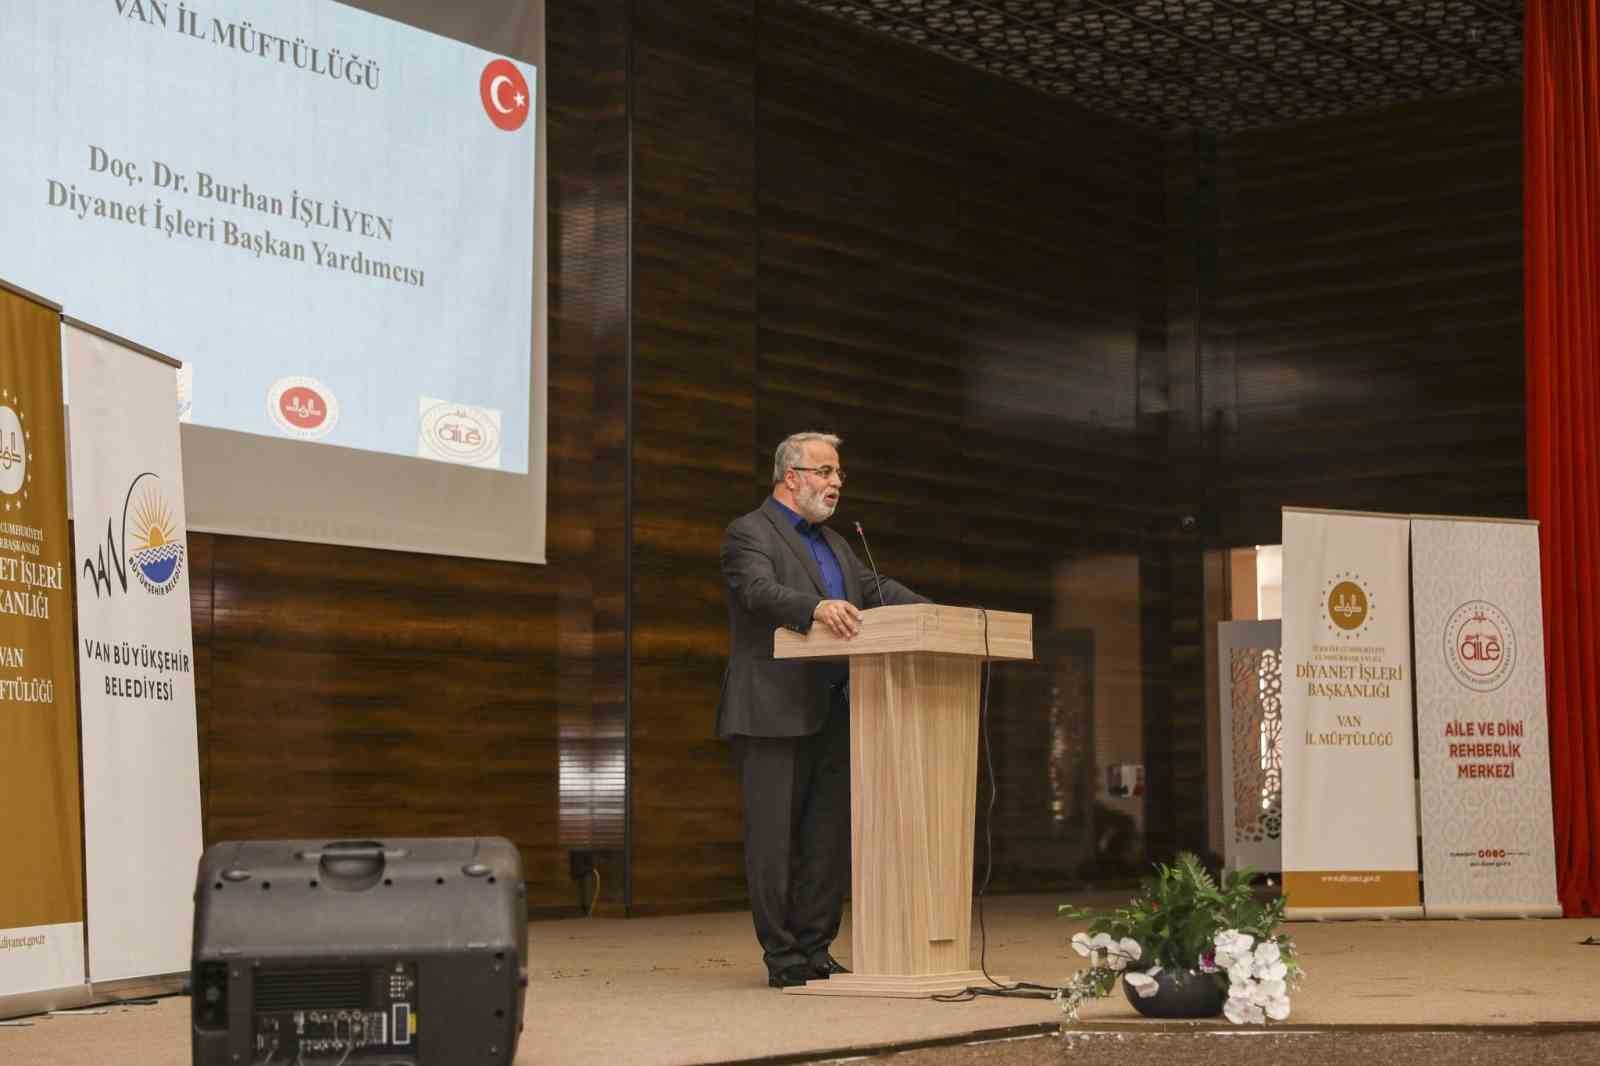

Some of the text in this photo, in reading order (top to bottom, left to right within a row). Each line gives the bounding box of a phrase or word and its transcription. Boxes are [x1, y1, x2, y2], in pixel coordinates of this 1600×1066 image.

[115, 0, 380, 90] VAN İL MÜFTÜLÜĞÜ
[88, 144, 393, 241] Doç. Dr. Burhan İŞLİYEN
[47, 178, 425, 287] Diyanet İşleri Başkan Yardımcısı
[20, 555, 63, 591] İŞLERİ
[85, 638, 190, 673] VAN BÜYÜKŞEHİR
[1296, 660, 1402, 683] DİYANET İŞLERİ
[105, 675, 173, 701] BELEDİYESİ
[1308, 682, 1391, 700] BAŞKANLIĞI
[1337, 715, 1361, 728] VAN
[1445, 719, 1524, 737] AİLE VE DİNİ
[1305, 728, 1393, 746] İL MÜFTÜLÜĞÜ
[1449, 740, 1521, 758] REHBERLİK
[1458, 760, 1515, 779] MERKEZİ
